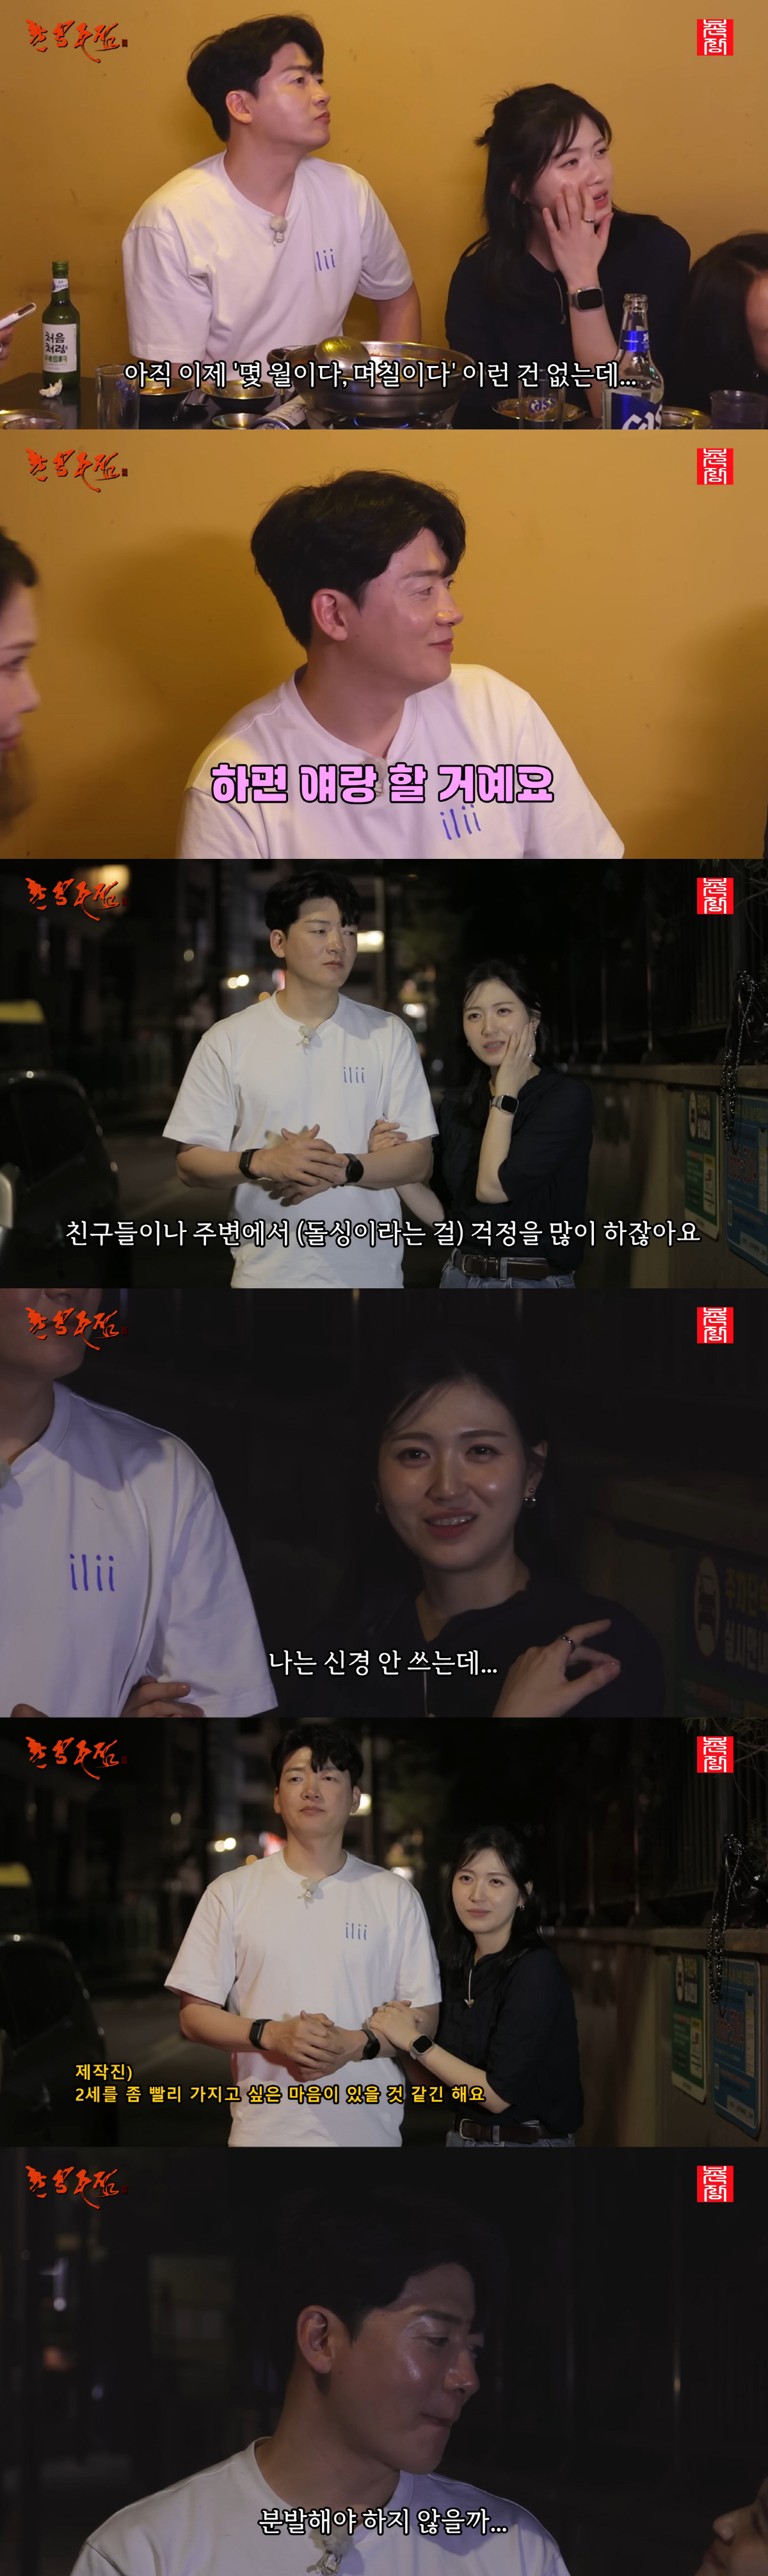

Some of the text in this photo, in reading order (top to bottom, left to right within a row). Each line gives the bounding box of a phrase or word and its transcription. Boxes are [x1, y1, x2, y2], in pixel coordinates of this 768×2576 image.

[45, 332, 65, 343] 처음
[45, 342, 66, 354] 처럼
[440, 804, 481, 840] ilii
[343, 1066, 365, 1084] ilii
[70, 1553, 115, 1592] ilii
[346, 1922, 367, 1940] ilii
